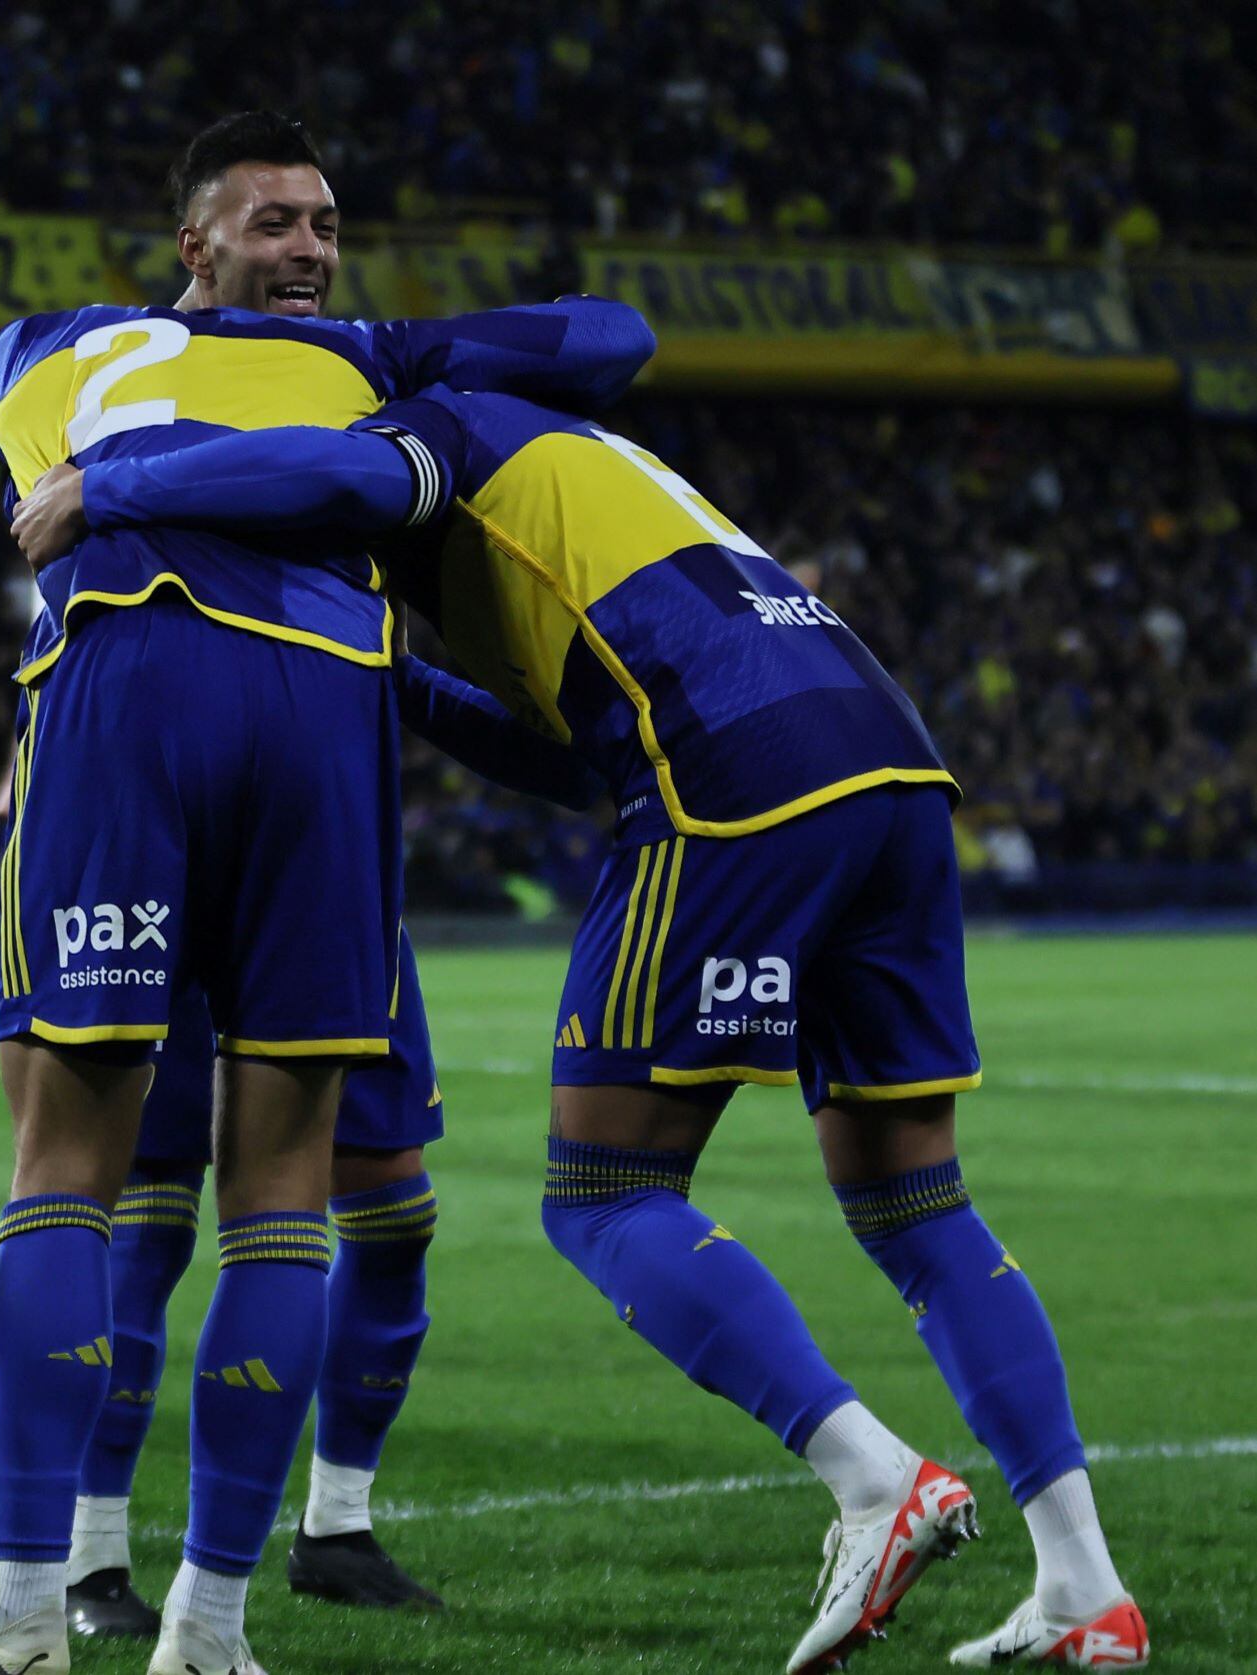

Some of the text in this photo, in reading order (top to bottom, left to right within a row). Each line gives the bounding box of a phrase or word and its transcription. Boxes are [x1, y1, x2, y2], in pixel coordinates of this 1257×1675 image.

[66, 317, 191, 456] 2
[738, 590, 848, 629] DIREC
[52, 899, 171, 968] pax
[59, 965, 167, 990] assistance
